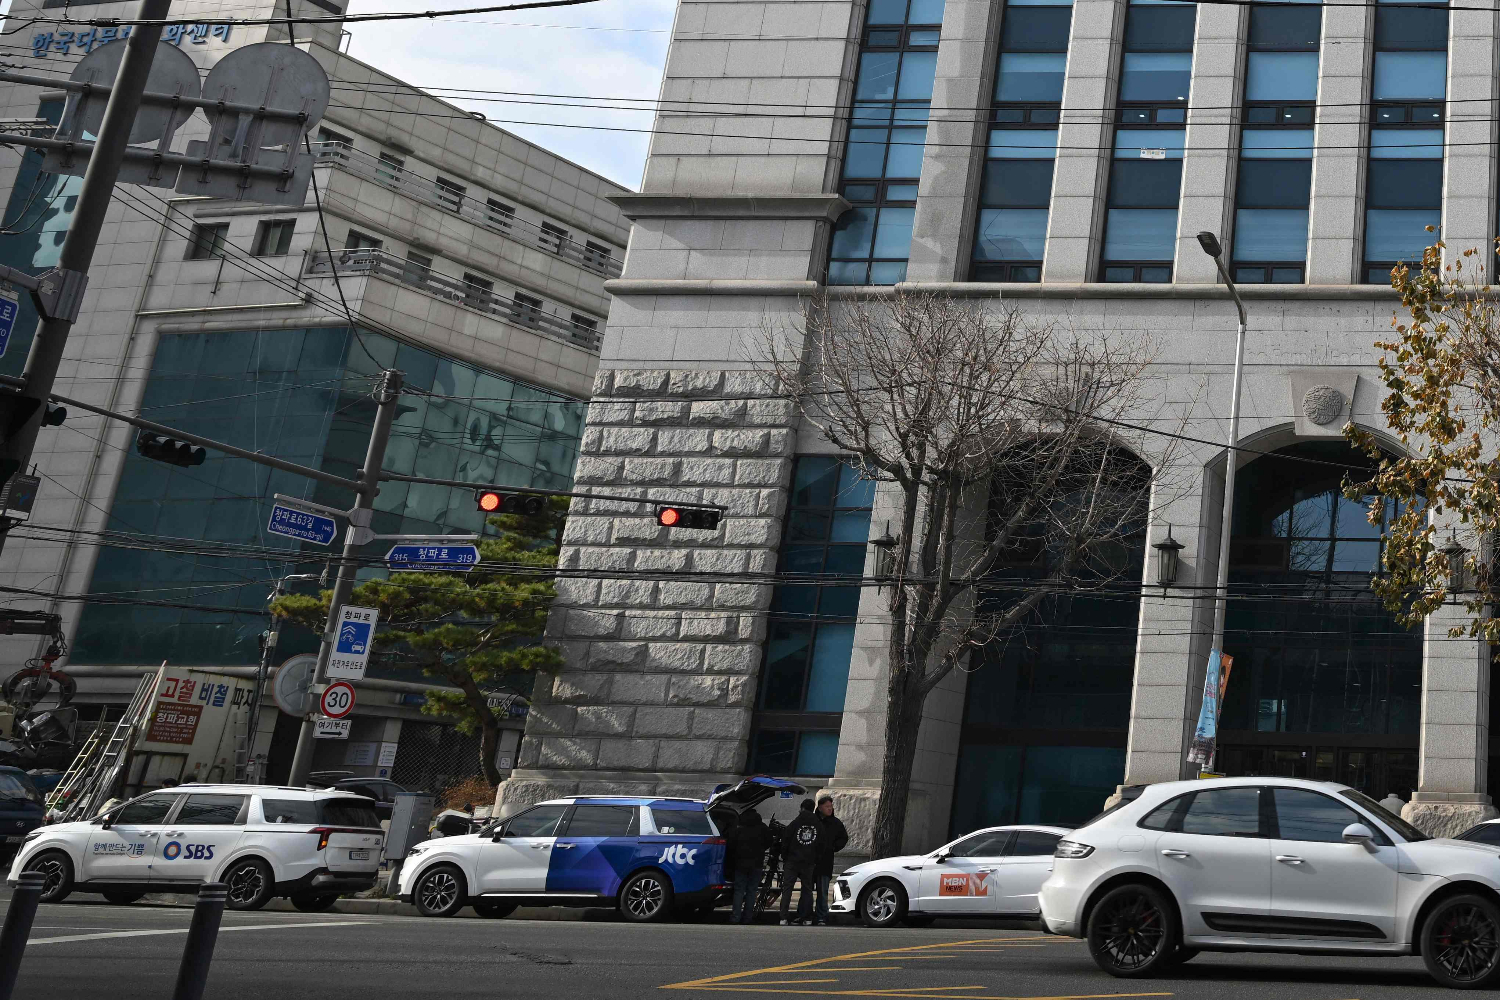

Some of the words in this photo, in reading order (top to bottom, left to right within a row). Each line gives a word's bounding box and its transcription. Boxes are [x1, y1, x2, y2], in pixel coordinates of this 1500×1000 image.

[31, 25, 231, 57] 한국다문화센터
[274, 508, 315, 528] 청파로63길
[418, 548, 449, 559] 청파로
[457, 554, 473, 563] 319
[345, 610, 371, 621] 청파로
[331, 660, 364, 670] 자전거우선도로
[160, 677, 197, 703] 고철
[199, 682, 229, 707] 비철
[327, 691, 349, 708] 30
[156, 712, 197, 726] 청파교회
[318, 721, 349, 730] 여기부터
[93, 843, 107, 852] 함께
[108, 843, 126, 852] 만드는
[127, 843, 145, 855] 기쁨
[183, 844, 216, 860] SBS
[943, 877, 967, 885] MBN
